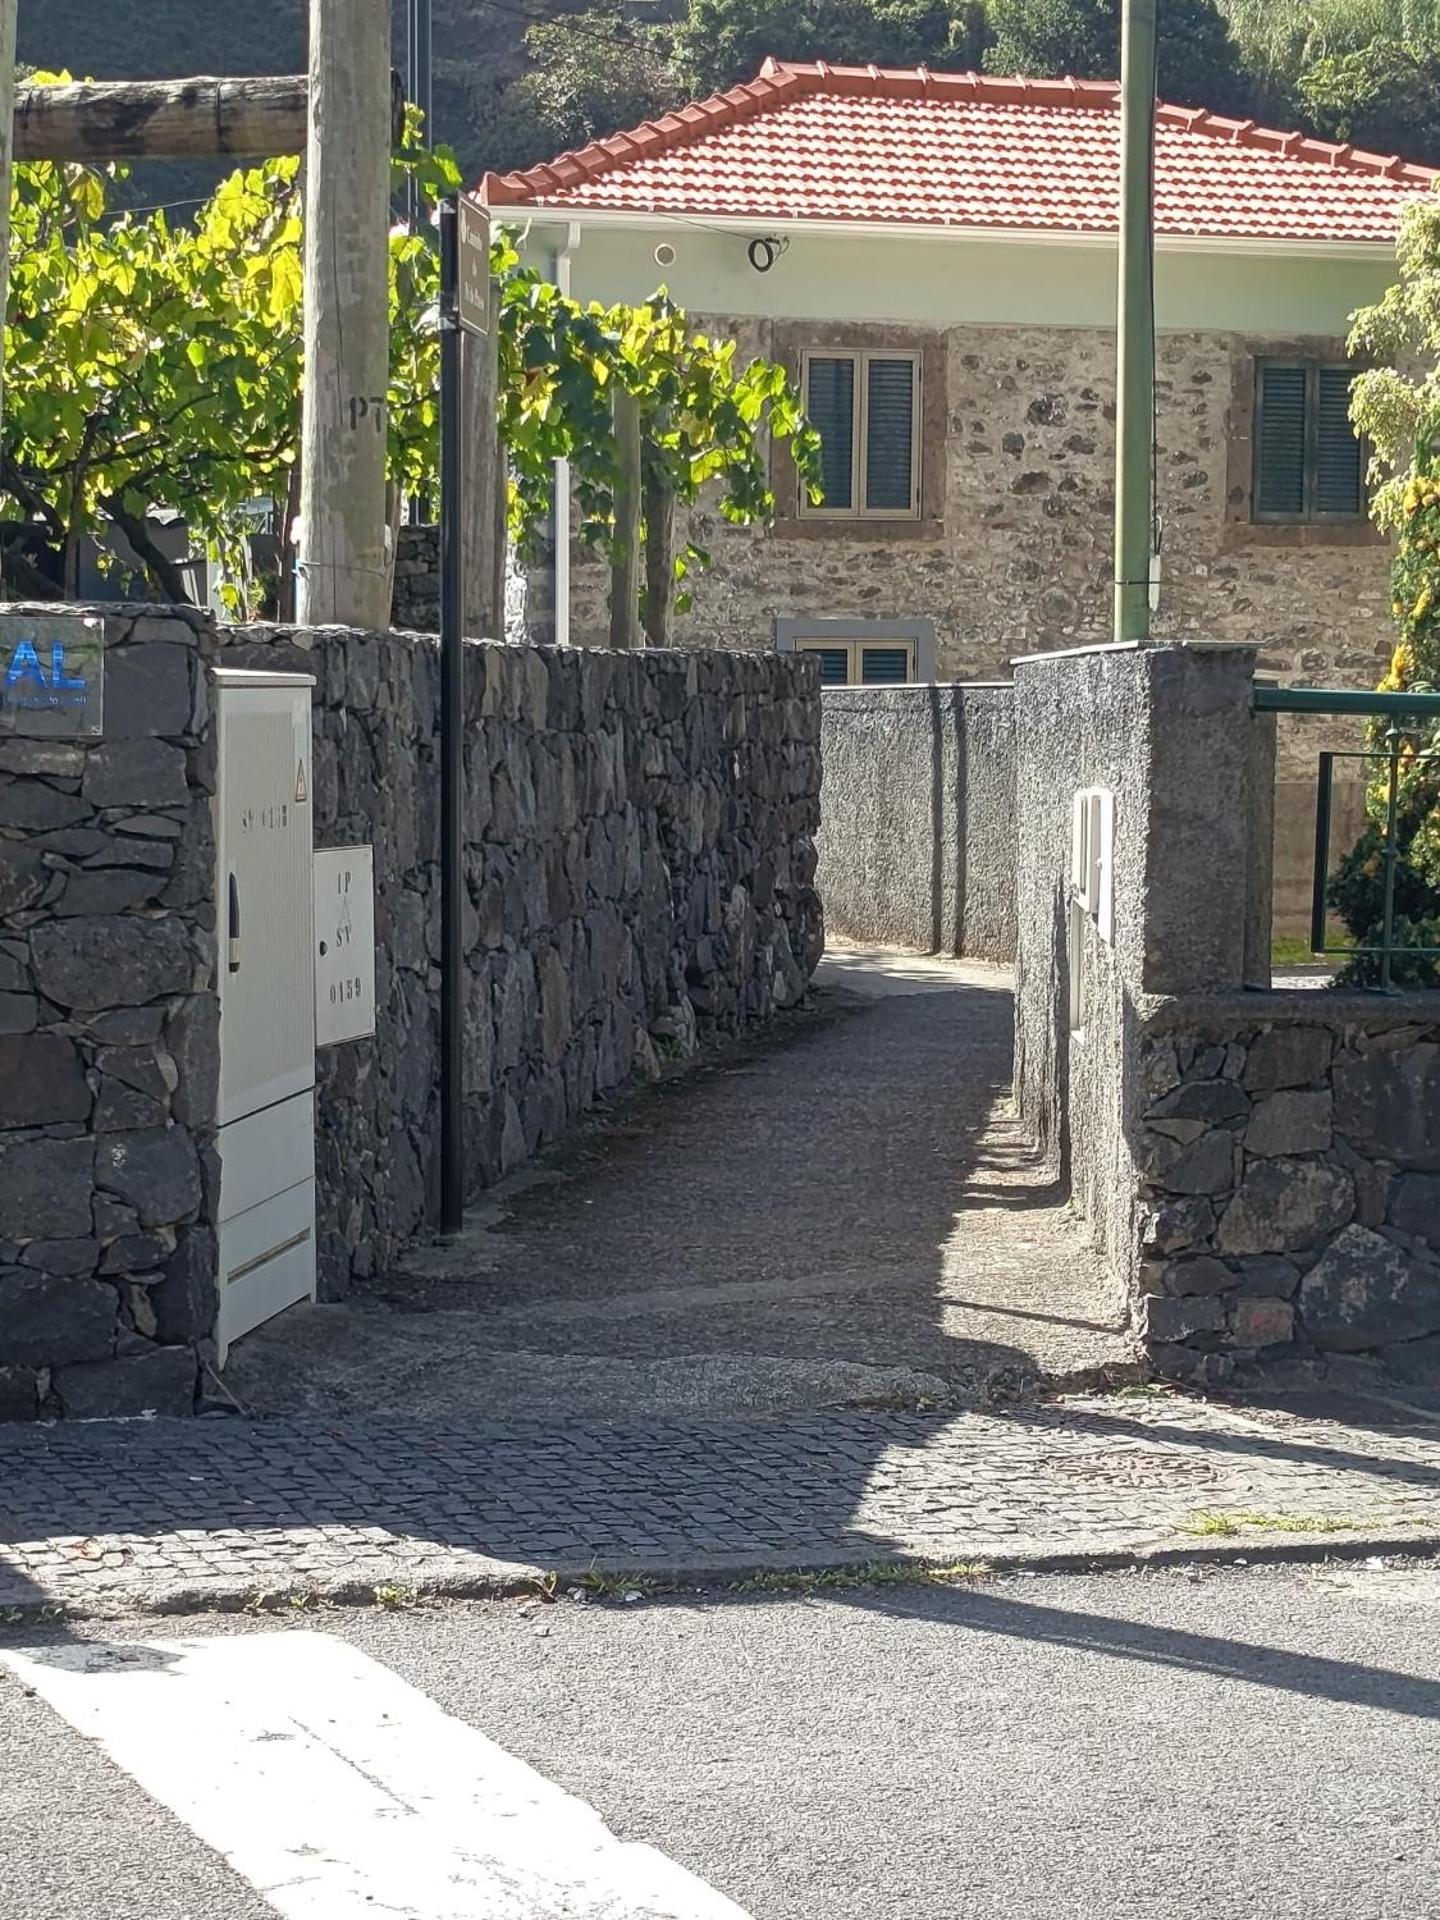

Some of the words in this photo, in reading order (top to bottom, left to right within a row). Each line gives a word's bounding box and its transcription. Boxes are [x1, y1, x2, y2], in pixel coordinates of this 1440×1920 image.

[4, 639, 86, 689] AL
[337, 871, 352, 894] IP
[329, 976, 361, 1004] 0159
